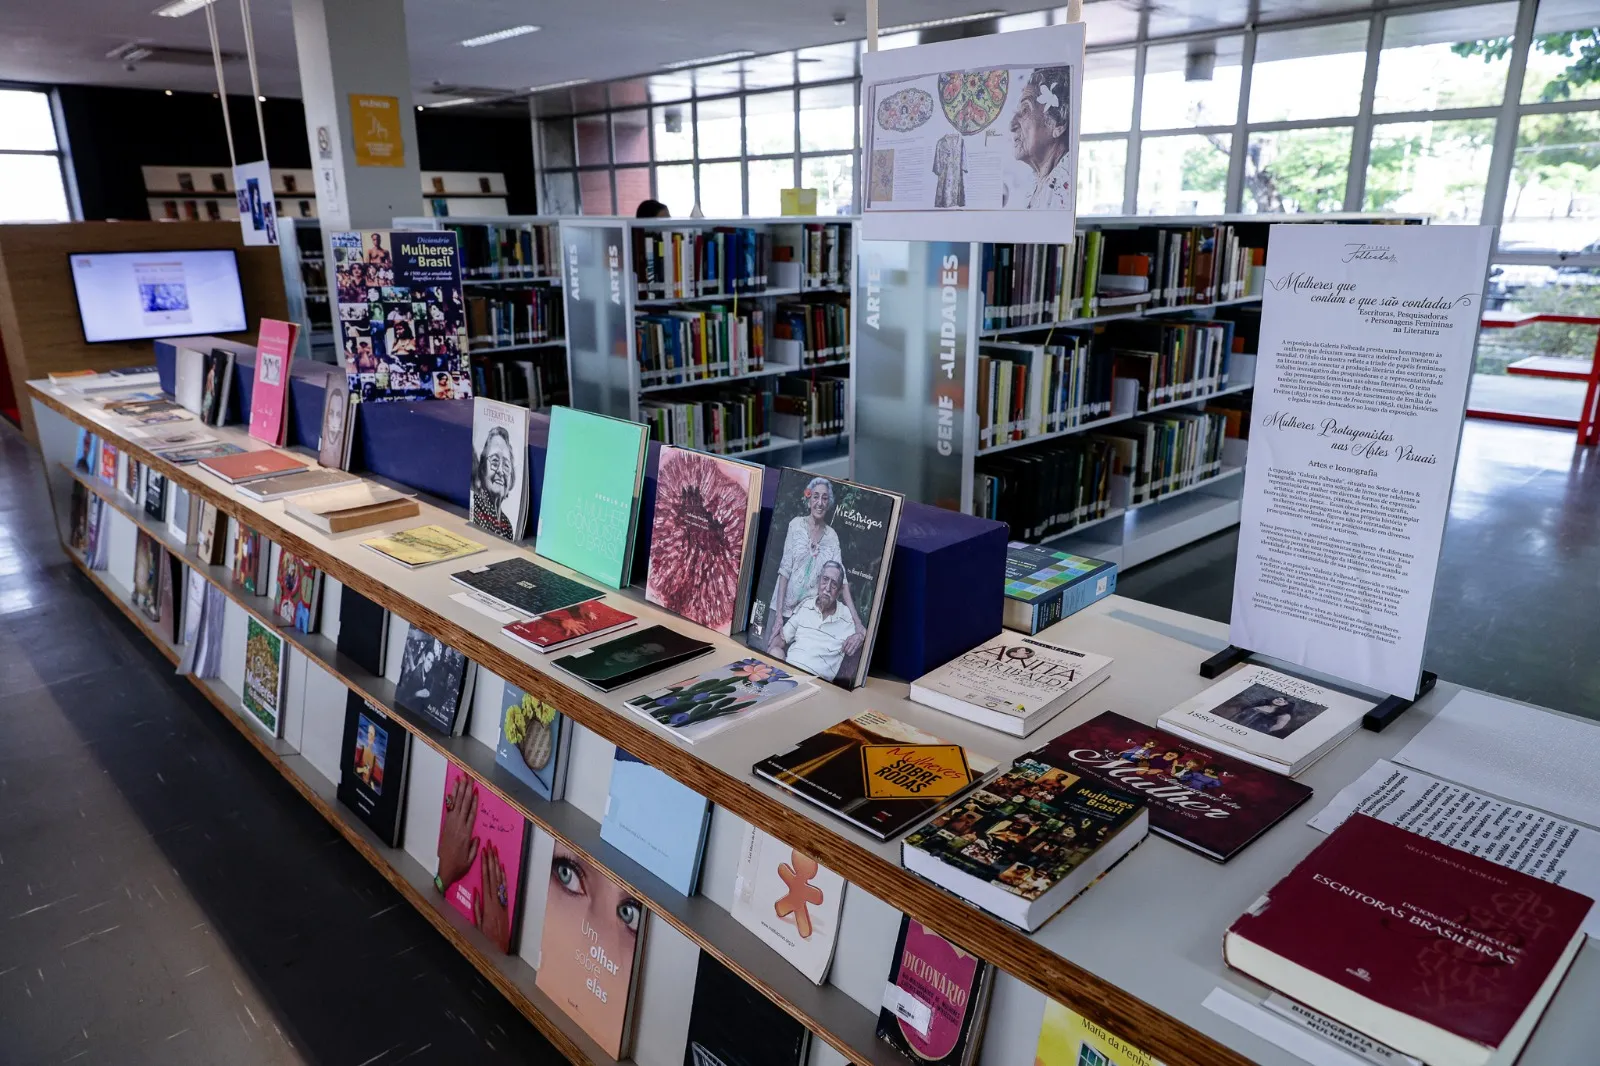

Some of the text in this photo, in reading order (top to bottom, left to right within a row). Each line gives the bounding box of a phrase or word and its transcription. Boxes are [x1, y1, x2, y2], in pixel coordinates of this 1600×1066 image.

[401, 244, 454, 256] Mulheres
[418, 256, 452, 268] Brasil
[569, 244, 580, 300] ARTES
[608, 245, 620, 305] ARTES
[1267, 272, 1357, 298] Mulheres que
[866, 253, 881, 330] ARTE
[1310, 293, 1346, 304] contam
[1358, 296, 1378, 310] que
[1381, 296, 1399, 308] são
[1402, 296, 1453, 310] contadas
[1359, 309, 1448, 321] Escritoras, Pesquisadoras
[1370, 317, 1414, 328] Personagens
[1415, 319, 1454, 329] Femininas
[1404, 326, 1440, 336] Literatura
[937, 254, 959, 456] GENEALIDADES
[1262, 411, 1394, 442] Mulheres Protagonistas
[1331, 440, 1437, 465] nas Artes Visuais
[1308, 460, 1327, 470] Artes
[1335, 462, 1378, 478] Iconografia
[973, 645, 1076, 682] ANITA
[886, 748, 965, 779] Mulheres
[890, 760, 942, 786] SOBRE
[874, 766, 927, 794] RODAS
[1068, 749, 1230, 819] Mulher
[1077, 788, 1135, 811] Mulheres
[1086, 798, 1126, 816] Brasil
[581, 918, 598, 944] Um
[1312, 872, 1517, 964] ESCRITORAS BRASILEIRAS
[575, 949, 600, 978] sobre
[590, 946, 619, 976] olhar
[586, 978, 608, 1004] elas
[902, 950, 966, 1007] DICIONÁRIO
[1082, 1018, 1150, 1066] Maria da Penha
[1291, 1004, 1393, 1058] BIBLIOGRAFIA DE
[1306, 1020, 1367, 1054] MULHERES
